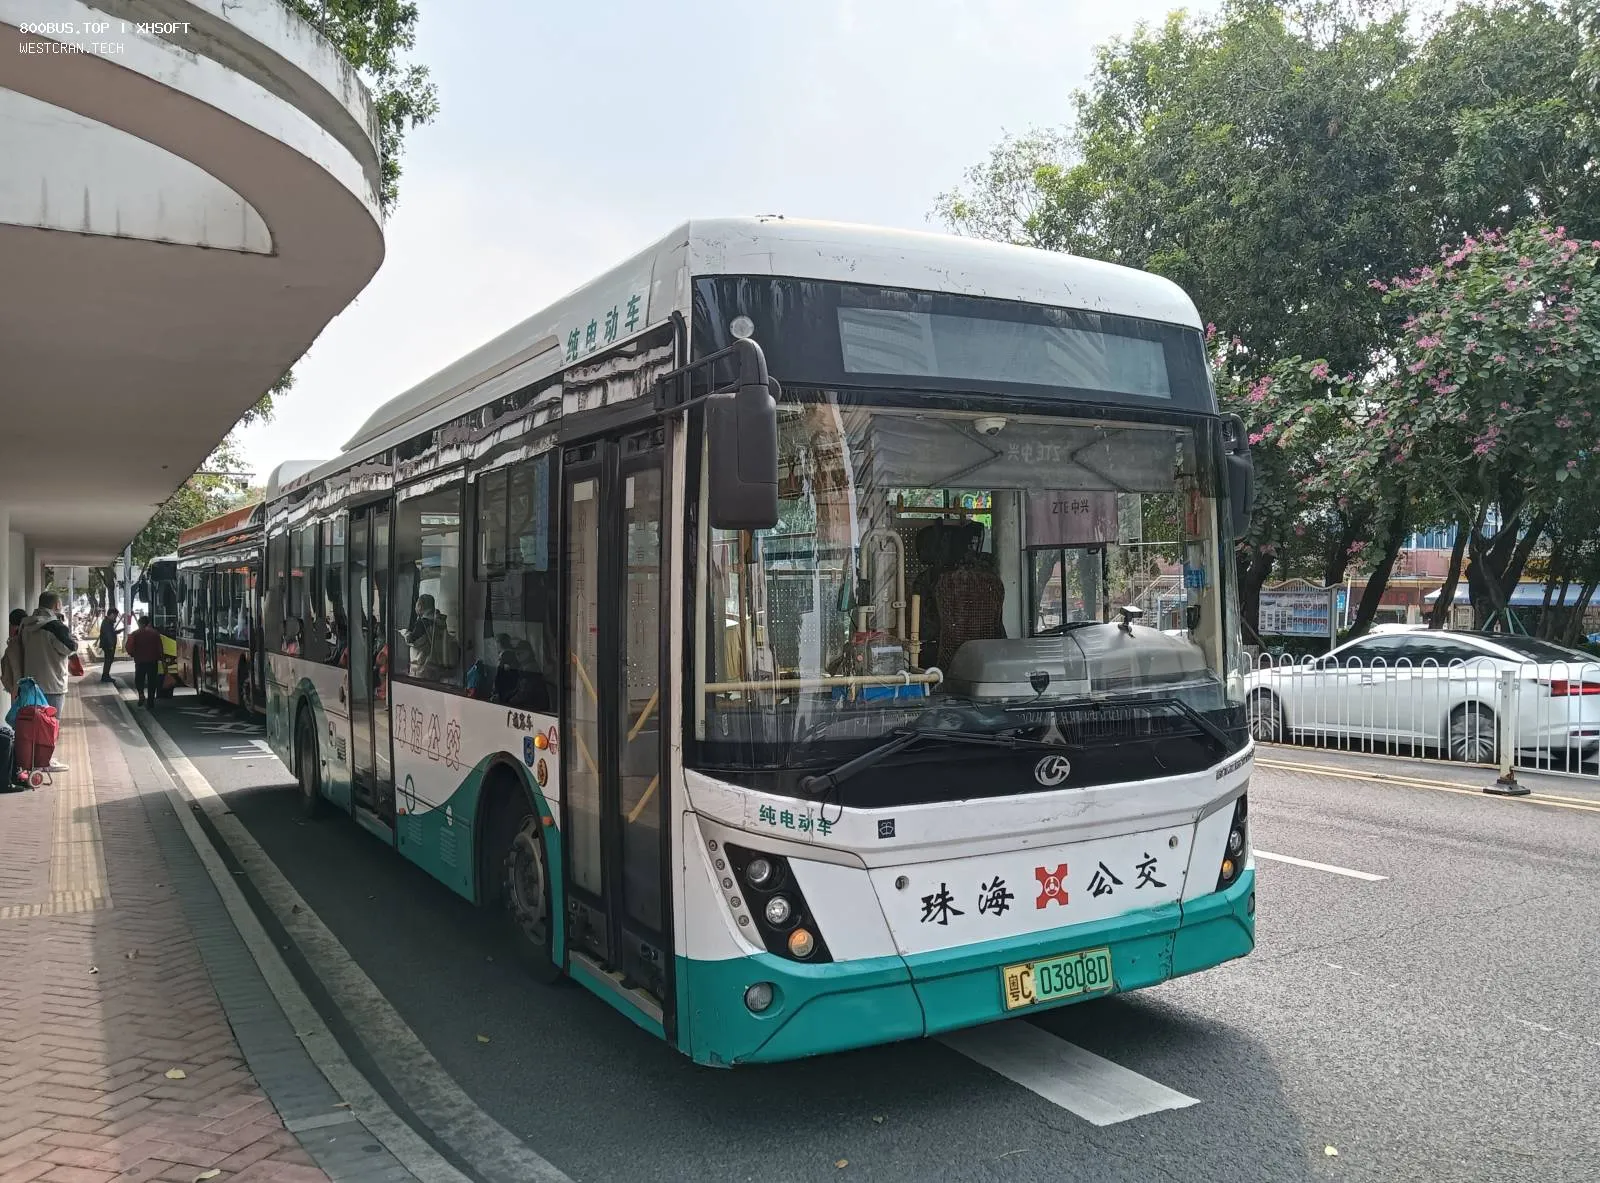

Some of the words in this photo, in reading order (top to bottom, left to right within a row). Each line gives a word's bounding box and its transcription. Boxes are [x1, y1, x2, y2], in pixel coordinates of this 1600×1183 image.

[566, 294, 641, 362] 纯电动车
[1052, 501, 1069, 514] ZTE
[1071, 499, 1089, 514] 中兴
[759, 804, 833, 837] 纯电动车
[920, 876, 1015, 926] 珠海
[1086, 852, 1168, 898] 公交
